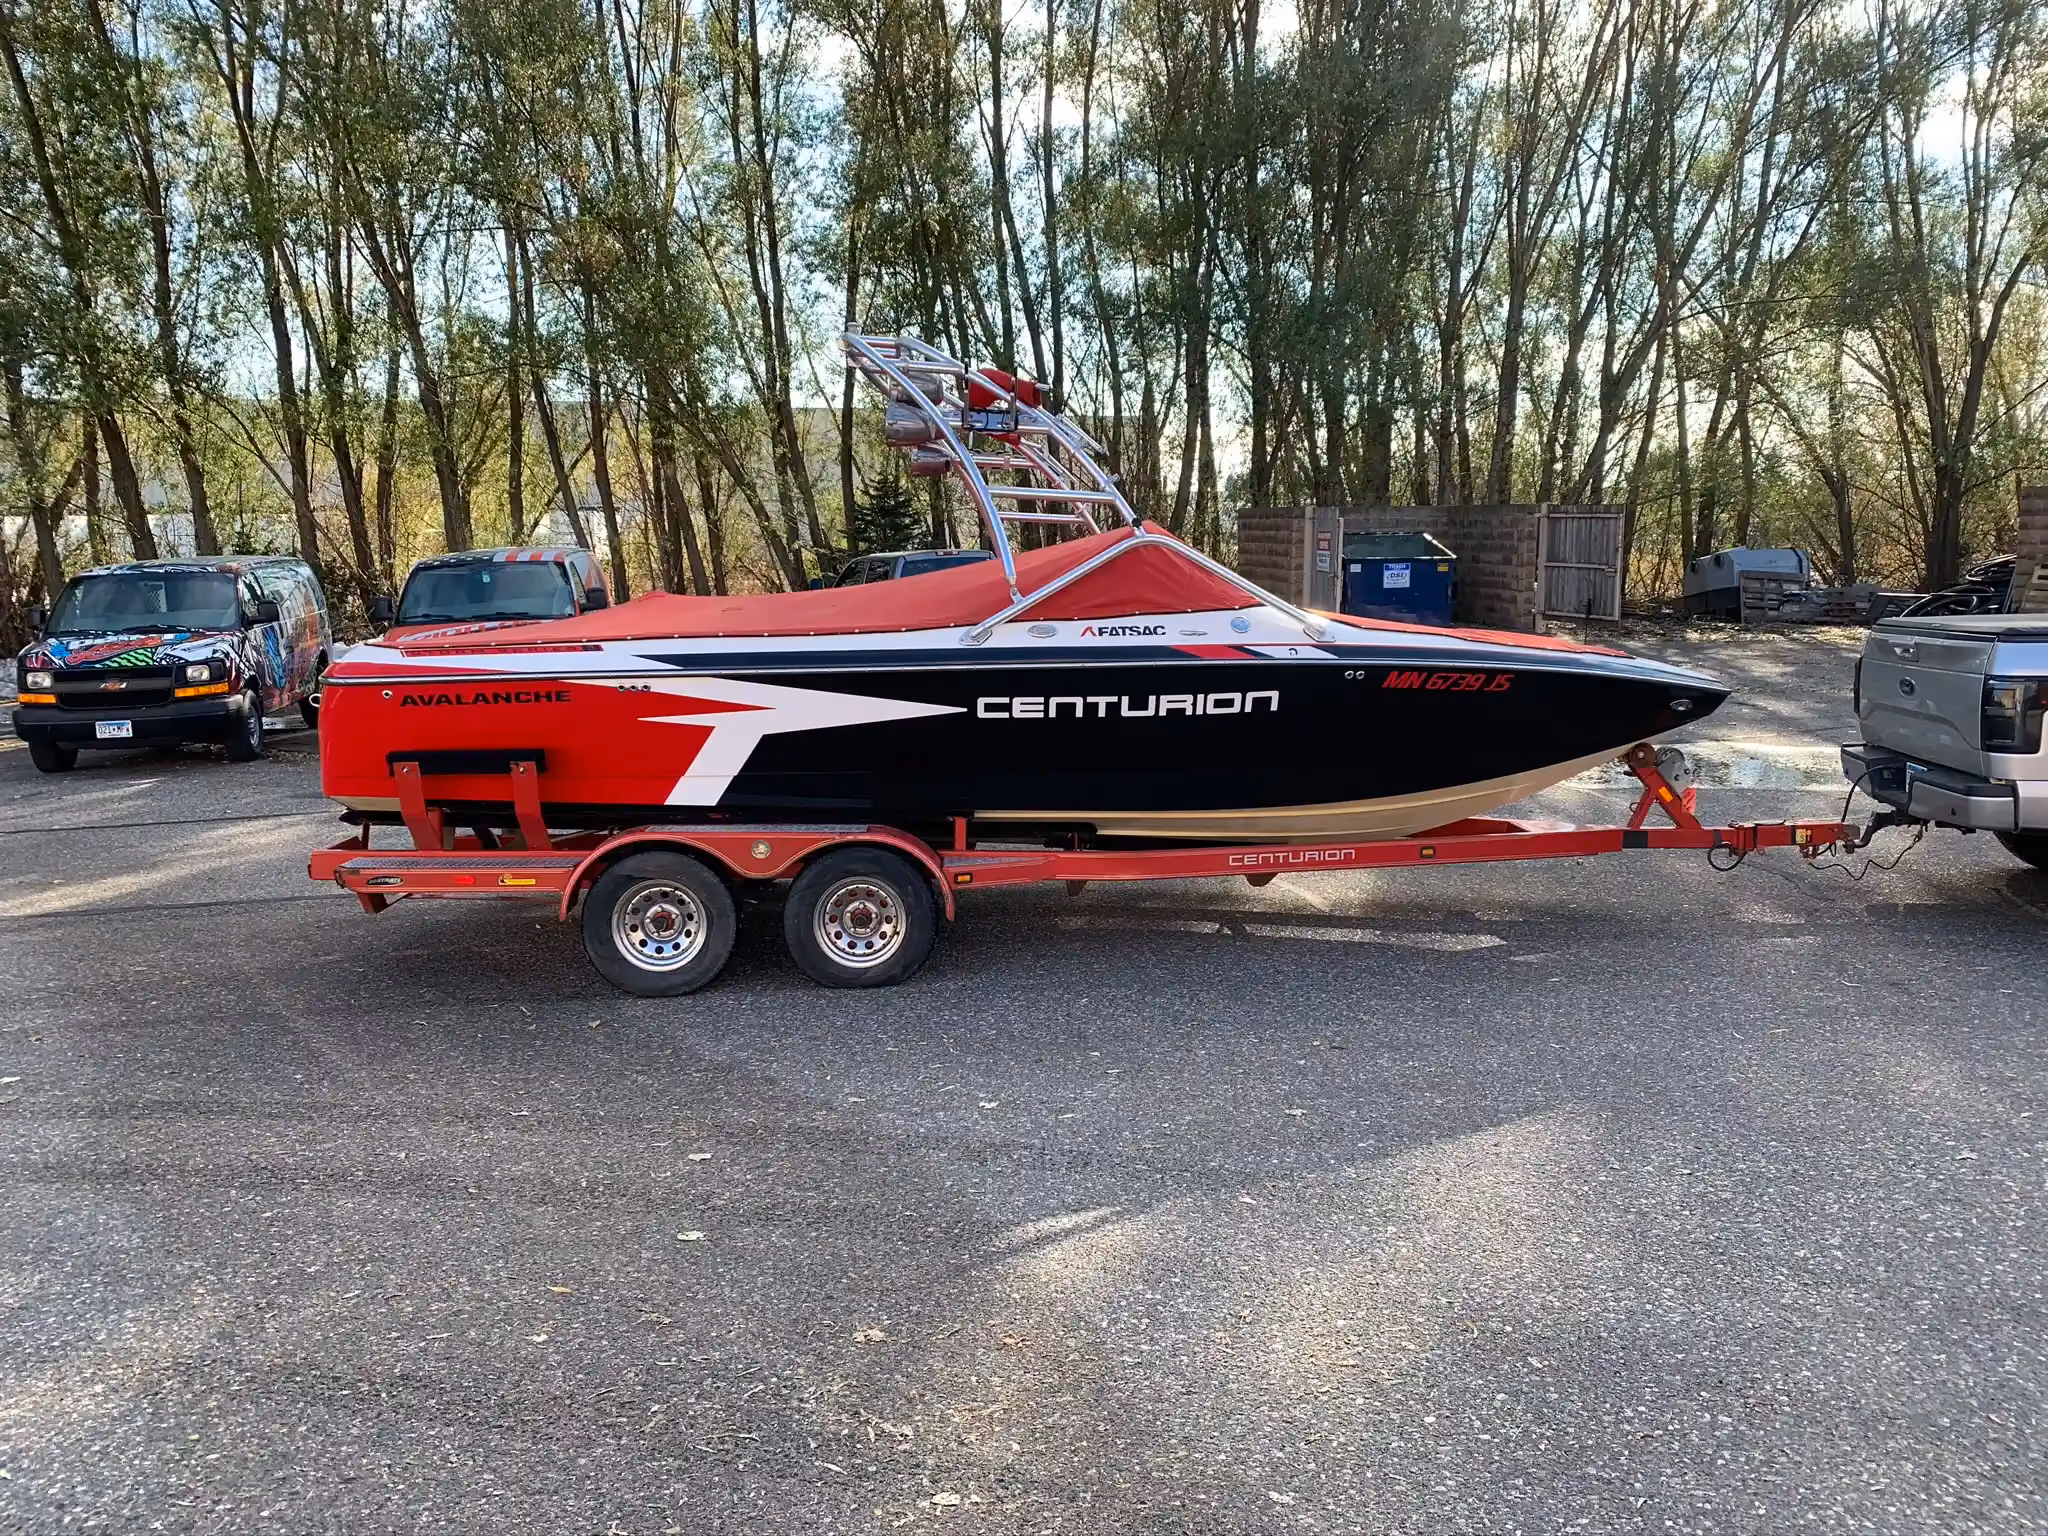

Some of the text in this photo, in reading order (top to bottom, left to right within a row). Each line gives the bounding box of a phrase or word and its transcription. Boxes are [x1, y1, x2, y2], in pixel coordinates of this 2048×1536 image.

[1098, 625, 1166, 637] FATSAC
[1381, 671, 1515, 691] MN 6739 JS
[400, 689, 572, 707] AVALANCHE
[977, 690, 1280, 718] CENTURION
[1229, 849, 1356, 866] CENTURION
